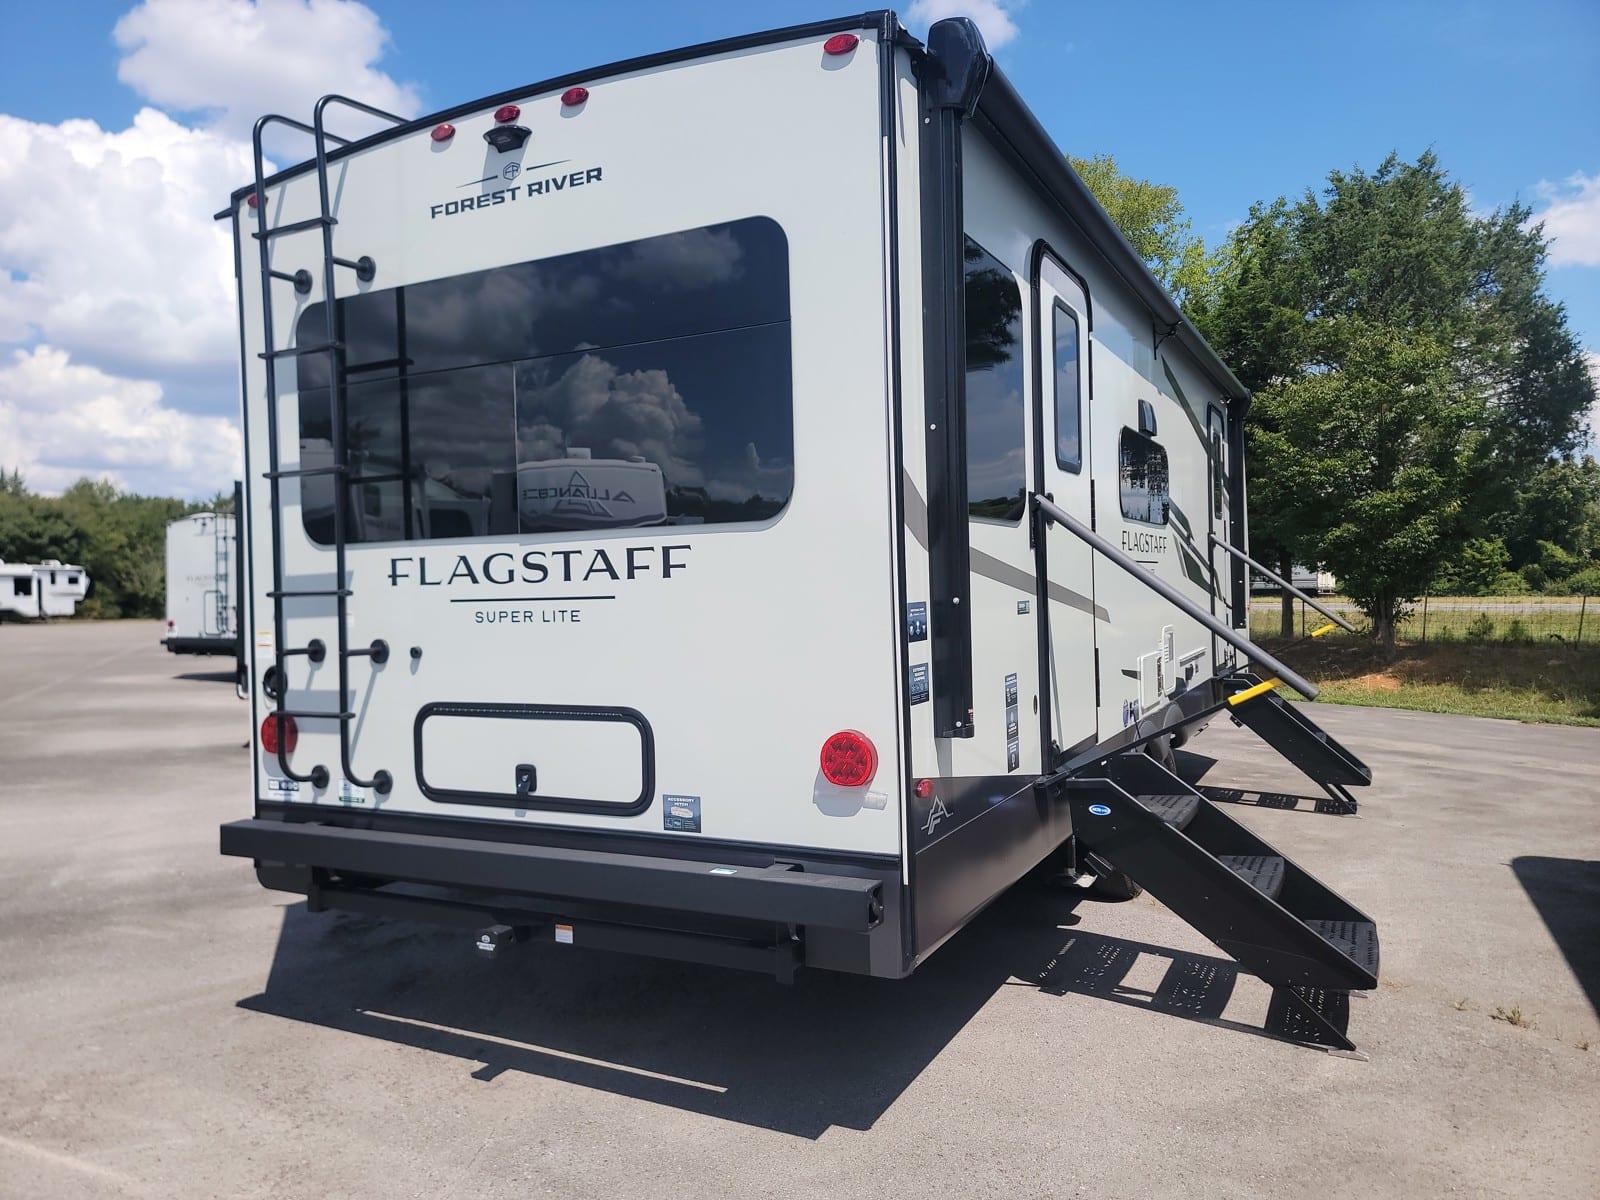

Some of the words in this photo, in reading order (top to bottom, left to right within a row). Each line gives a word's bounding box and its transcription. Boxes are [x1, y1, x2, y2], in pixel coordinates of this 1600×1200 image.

[430, 186, 521, 219] FOREST
[527, 166, 603, 197] RIVER
[1121, 530, 1168, 554] FLAGSTAFF
[387, 544, 692, 587] FLAGSTAFF
[475, 610, 534, 624] SUPER
[542, 609, 582, 623] LITE
